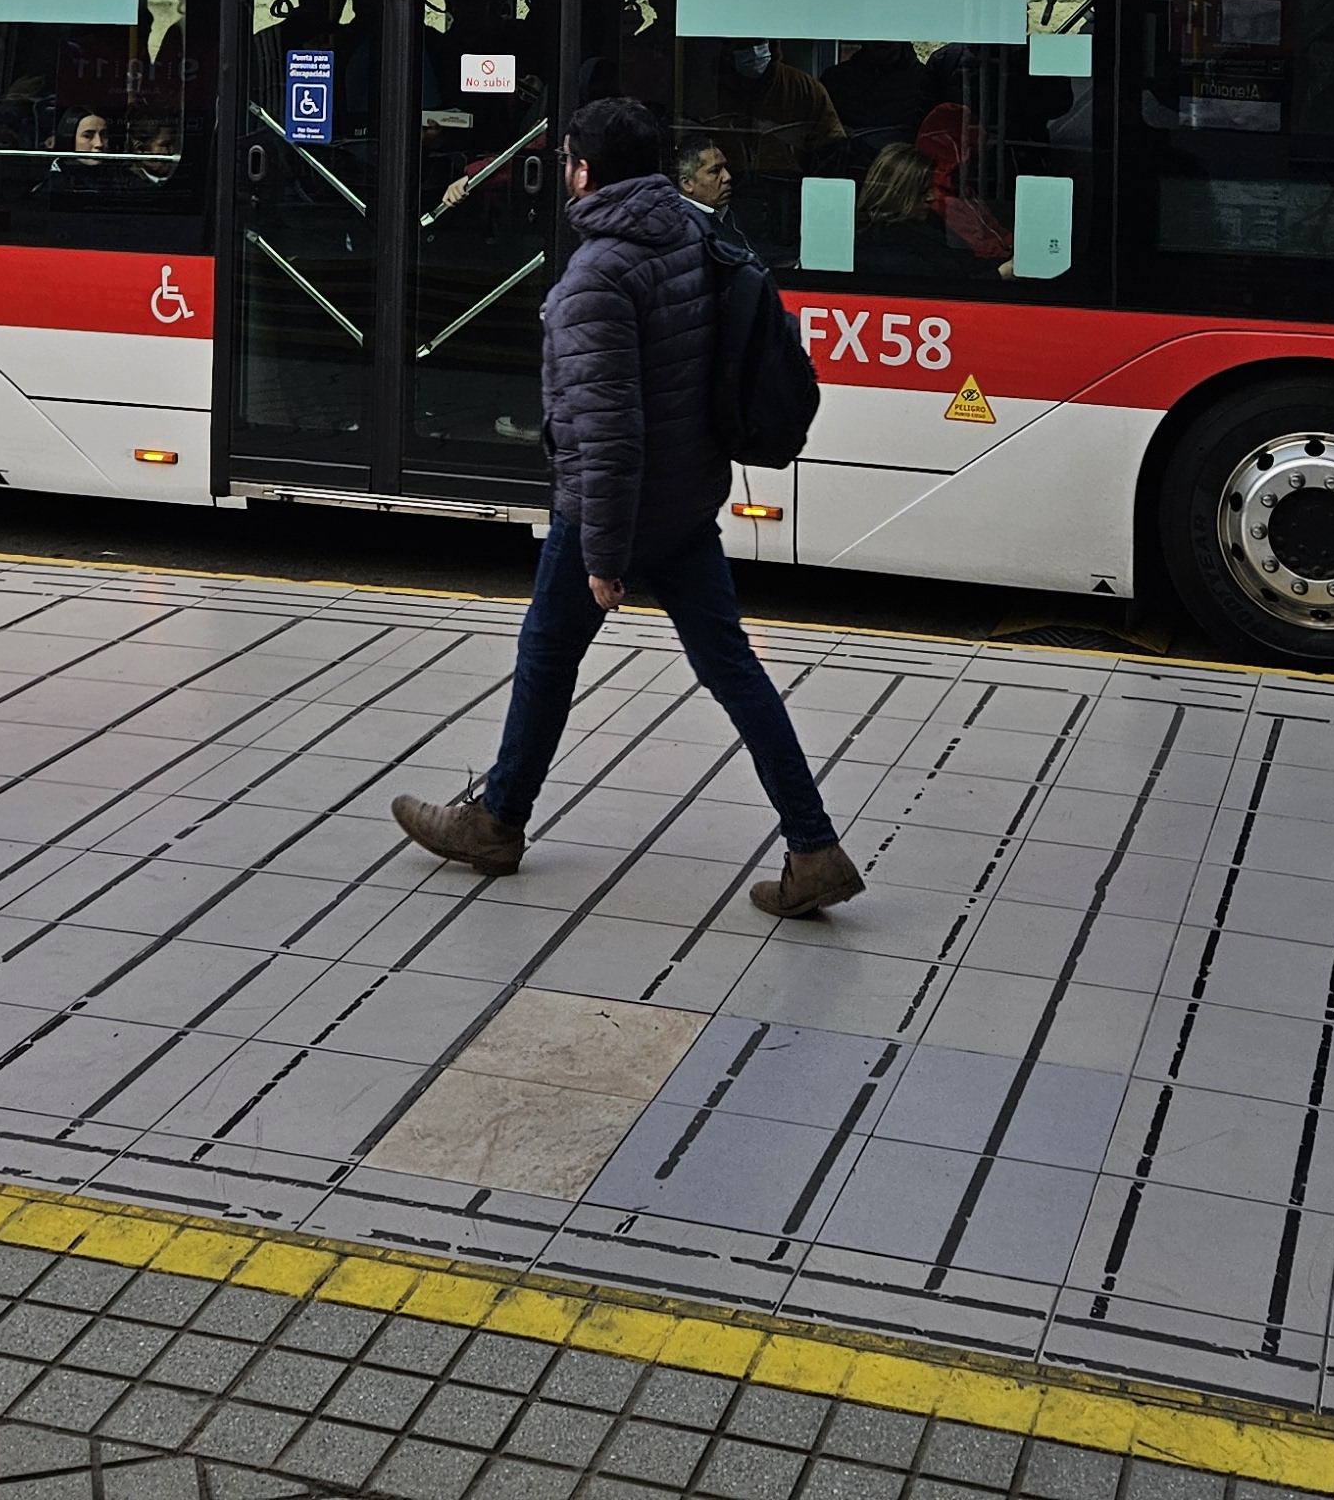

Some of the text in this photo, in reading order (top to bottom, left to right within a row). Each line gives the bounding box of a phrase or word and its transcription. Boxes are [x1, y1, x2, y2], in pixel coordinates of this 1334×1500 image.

[292, 53, 329, 63] Puerta para
[466, 77, 511, 87] No subir
[954, 404, 986, 413] PELIGRO
